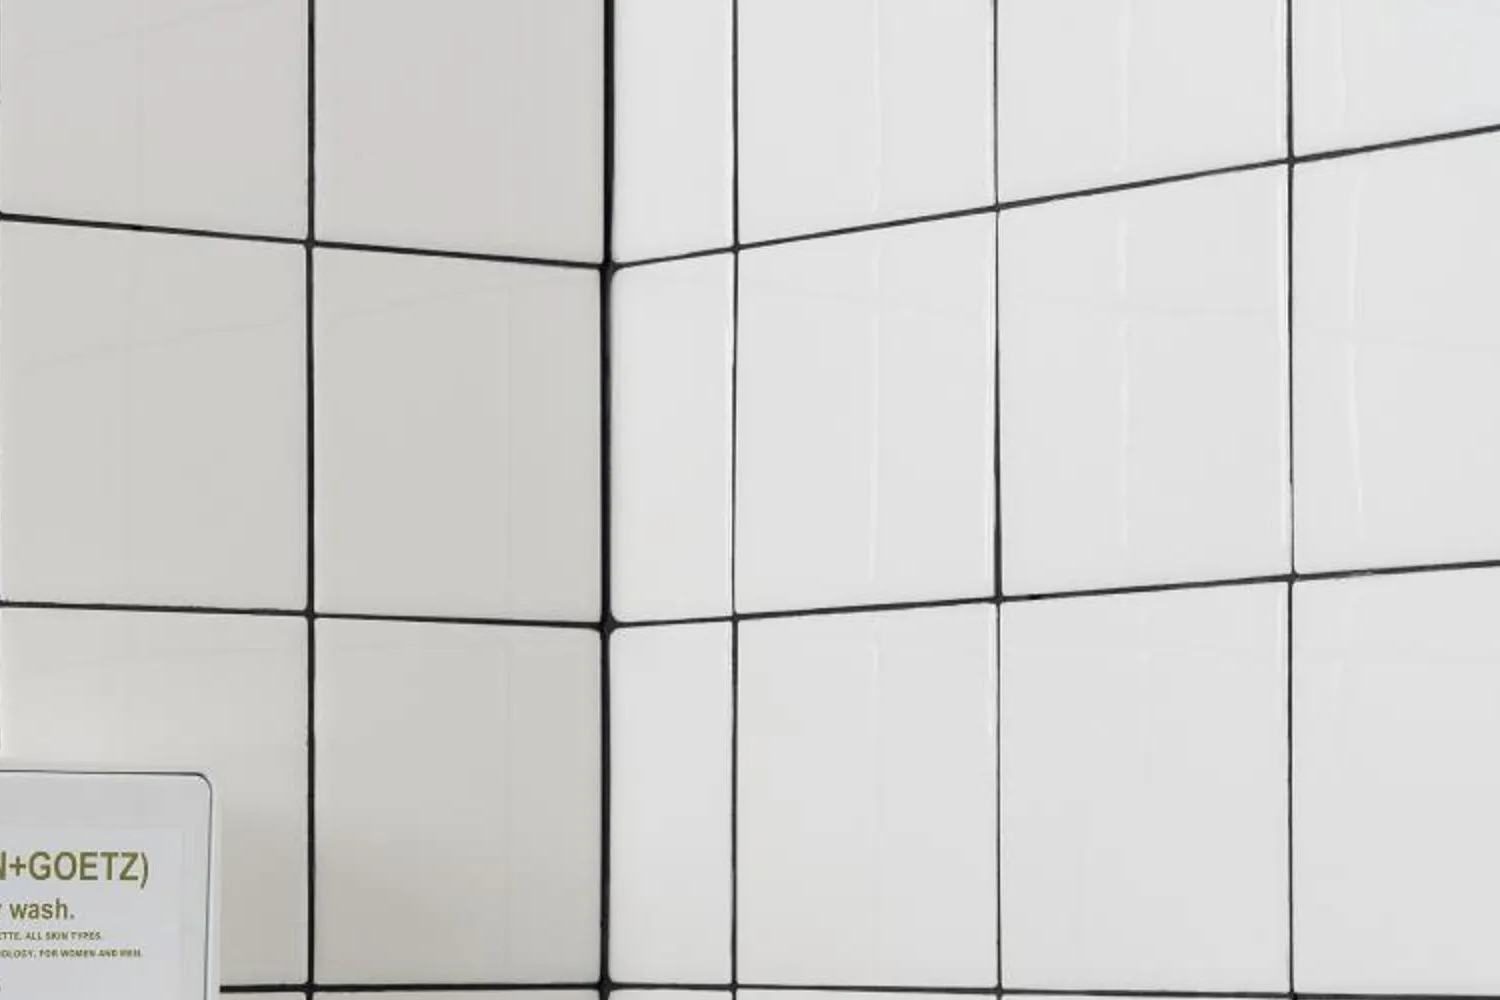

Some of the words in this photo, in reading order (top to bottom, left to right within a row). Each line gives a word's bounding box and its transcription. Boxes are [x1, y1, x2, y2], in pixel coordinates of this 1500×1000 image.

[8, 898, 75, 920] wash.
[25, 931, 43, 941] ALL
[39, 948, 58, 958] FOR
[59, 948, 97, 958] WOMEN
